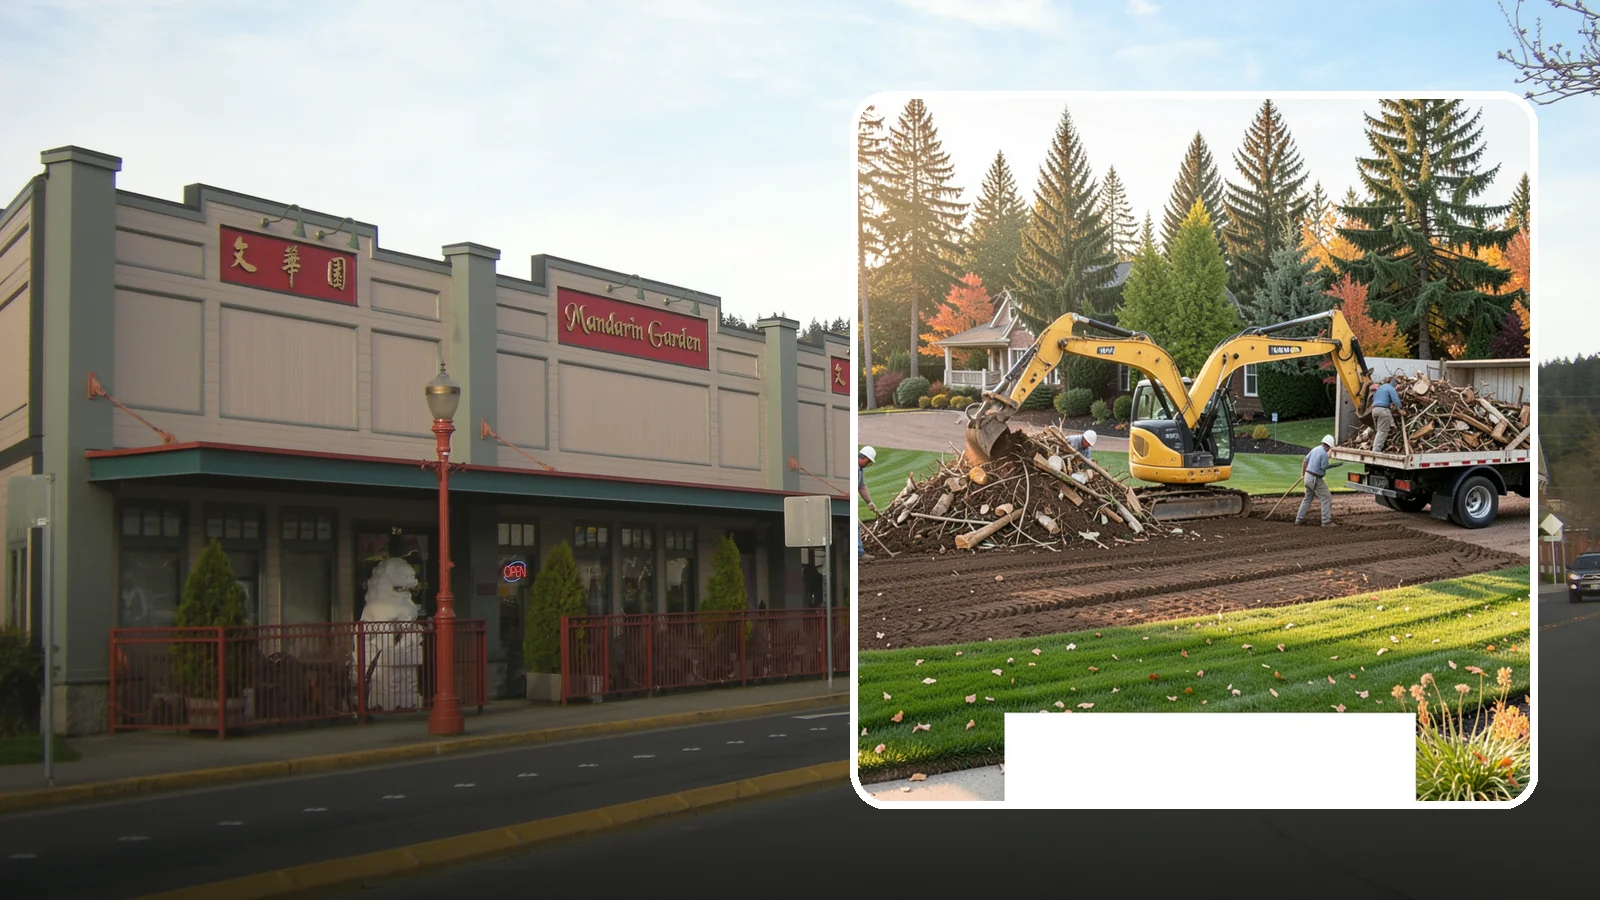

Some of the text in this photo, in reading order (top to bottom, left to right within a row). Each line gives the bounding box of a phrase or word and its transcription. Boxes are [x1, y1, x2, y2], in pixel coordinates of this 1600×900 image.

[230, 235, 346, 291] 文華園
[564, 302, 701, 352] Mandarin Garden
[503, 565, 527, 578] OPEN
